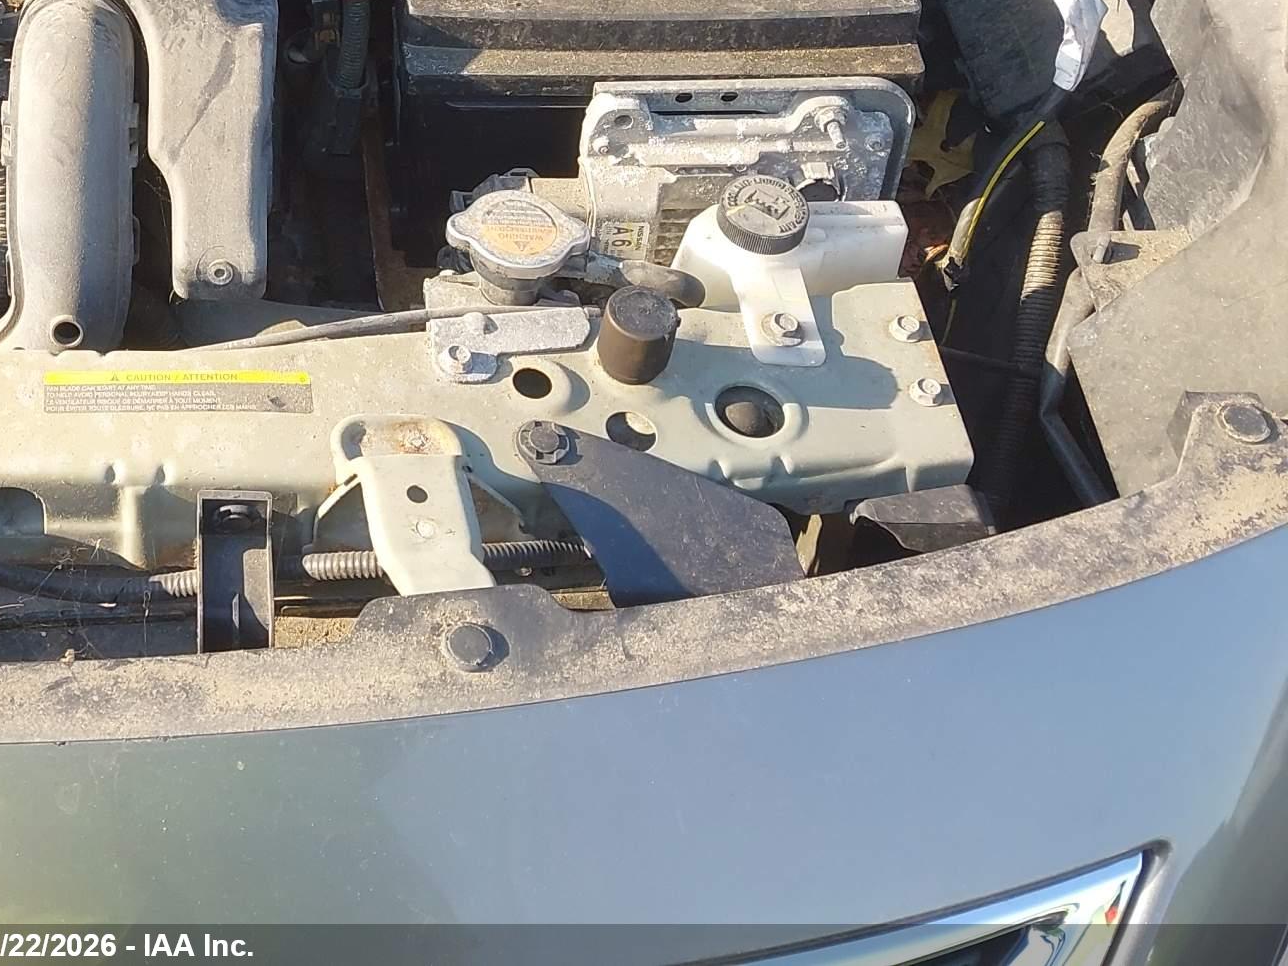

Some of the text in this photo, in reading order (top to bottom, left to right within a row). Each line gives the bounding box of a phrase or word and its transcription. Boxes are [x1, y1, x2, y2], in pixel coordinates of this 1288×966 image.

[635, 225, 644, 250] NISSAN
[125, 373, 171, 382] CAUTION
[182, 373, 238, 381] ATTENTION
